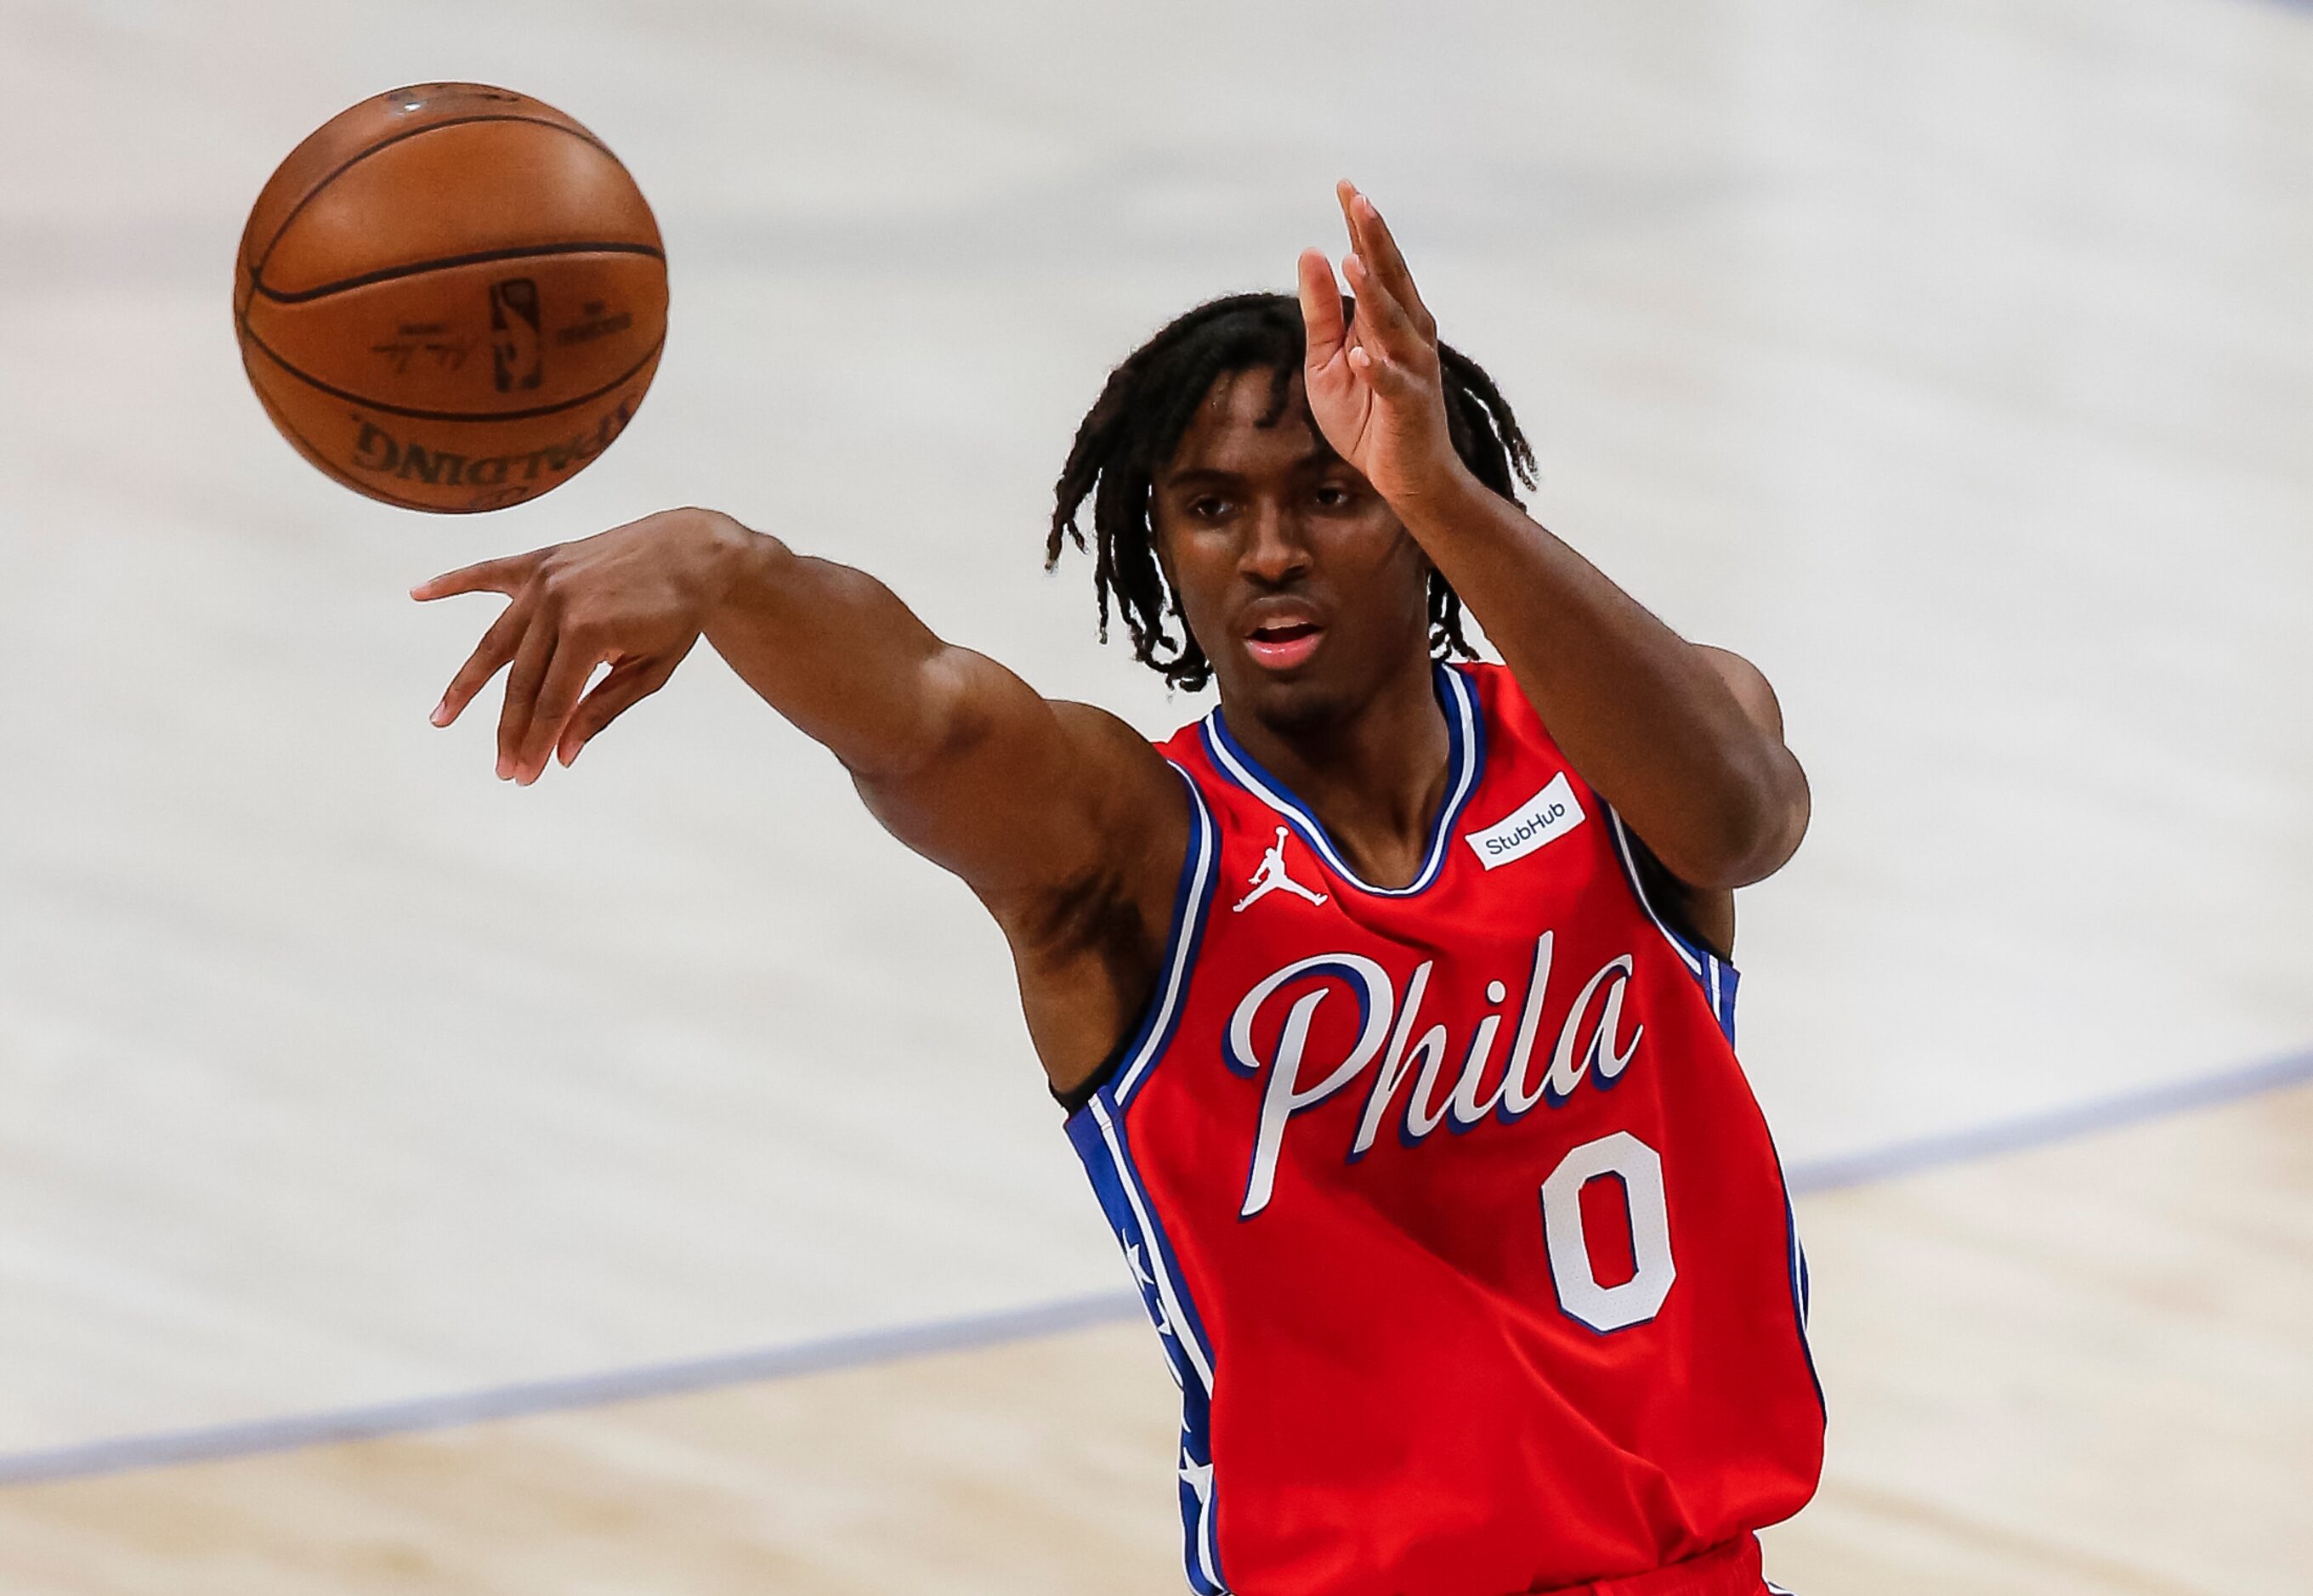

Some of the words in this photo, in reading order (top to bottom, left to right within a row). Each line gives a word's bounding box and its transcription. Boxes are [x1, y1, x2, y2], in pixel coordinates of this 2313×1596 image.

[1485, 803, 1565, 855] StubHub
[1221, 930, 1643, 1222] Phila
[1540, 1130, 1676, 1335] 0
